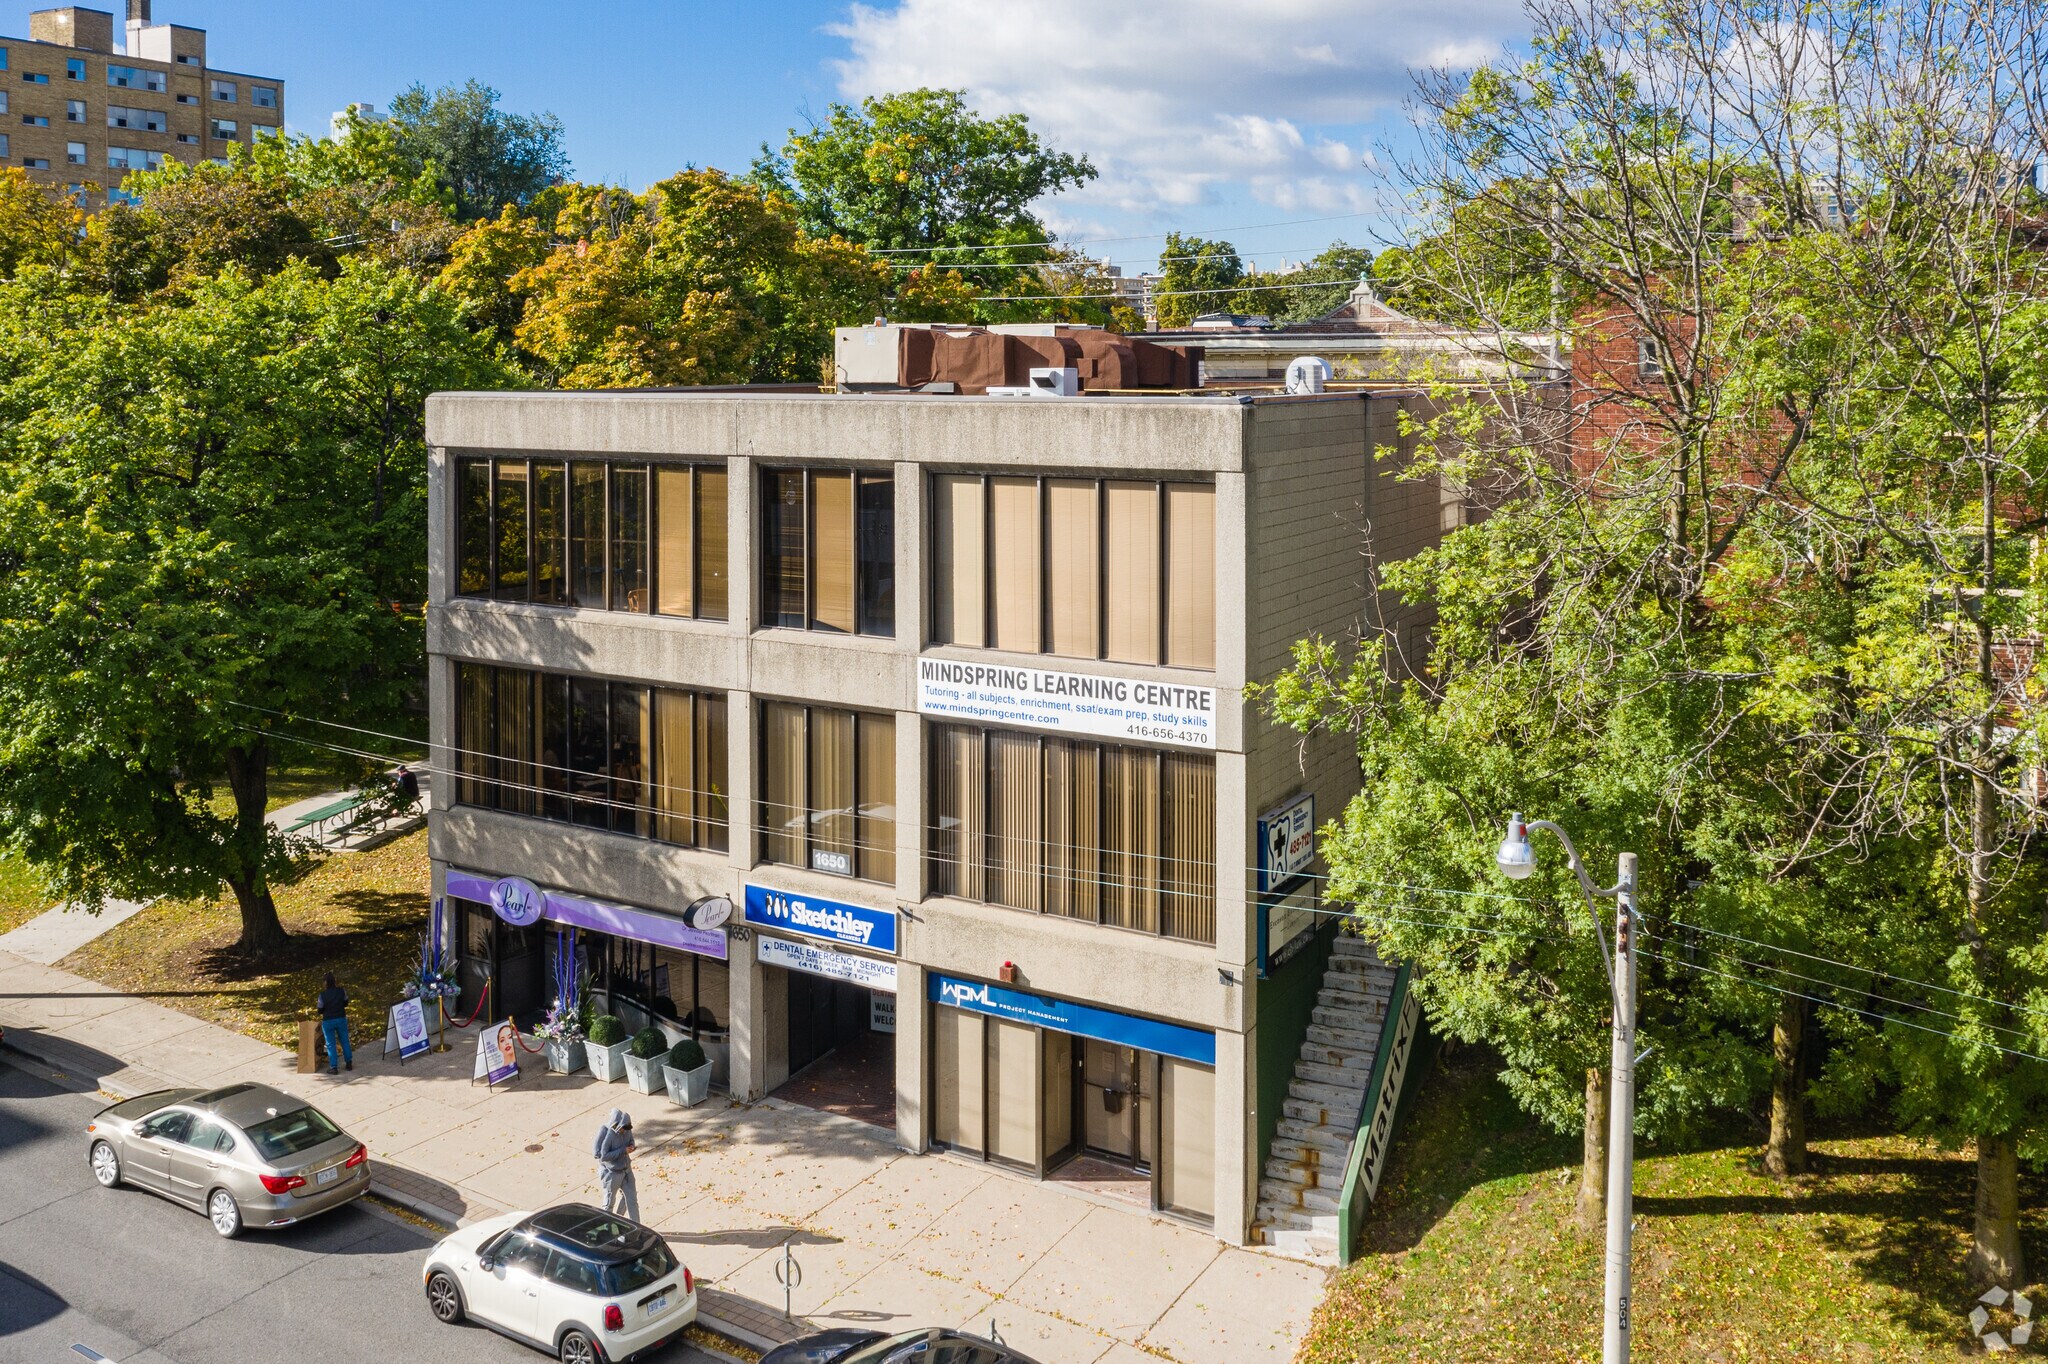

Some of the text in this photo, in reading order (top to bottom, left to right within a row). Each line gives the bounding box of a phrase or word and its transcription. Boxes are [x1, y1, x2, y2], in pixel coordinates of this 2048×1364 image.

[922, 662, 1211, 711] MINDSPRING LEARNING CENTRE
[925, 685, 959, 700] Tutoring
[966, 691, 977, 700] all
[979, 693, 1018, 705] subjects,
[1020, 699, 1073, 712] enrichment,
[1076, 704, 1123, 717] ssat/exam
[1125, 710, 1150, 721] prep,
[1152, 713, 1179, 726] study
[1182, 716, 1208, 727] skills
[925, 702, 1060, 725] www.mindspringcentre.com
[1127, 725, 1208, 744] 416-656-4370
[1290, 830, 1312, 855] 485-7121
[815, 852, 846, 869] 1650
[497, 881, 530, 920] Pearl
[701, 902, 722, 925] Pearl
[791, 901, 874, 944] Sketchley
[773, 941, 896, 976] DENTAL EMERGENCY SERVICE
[787, 953, 801, 961] OPEN
[805, 957, 818, 965] DAYS
[798, 961, 870, 981] (416) 485-7121
[999, 1003, 1069, 1023] PROJECT MANAGEMENT
[1619, 1299, 1627, 1328] 504
